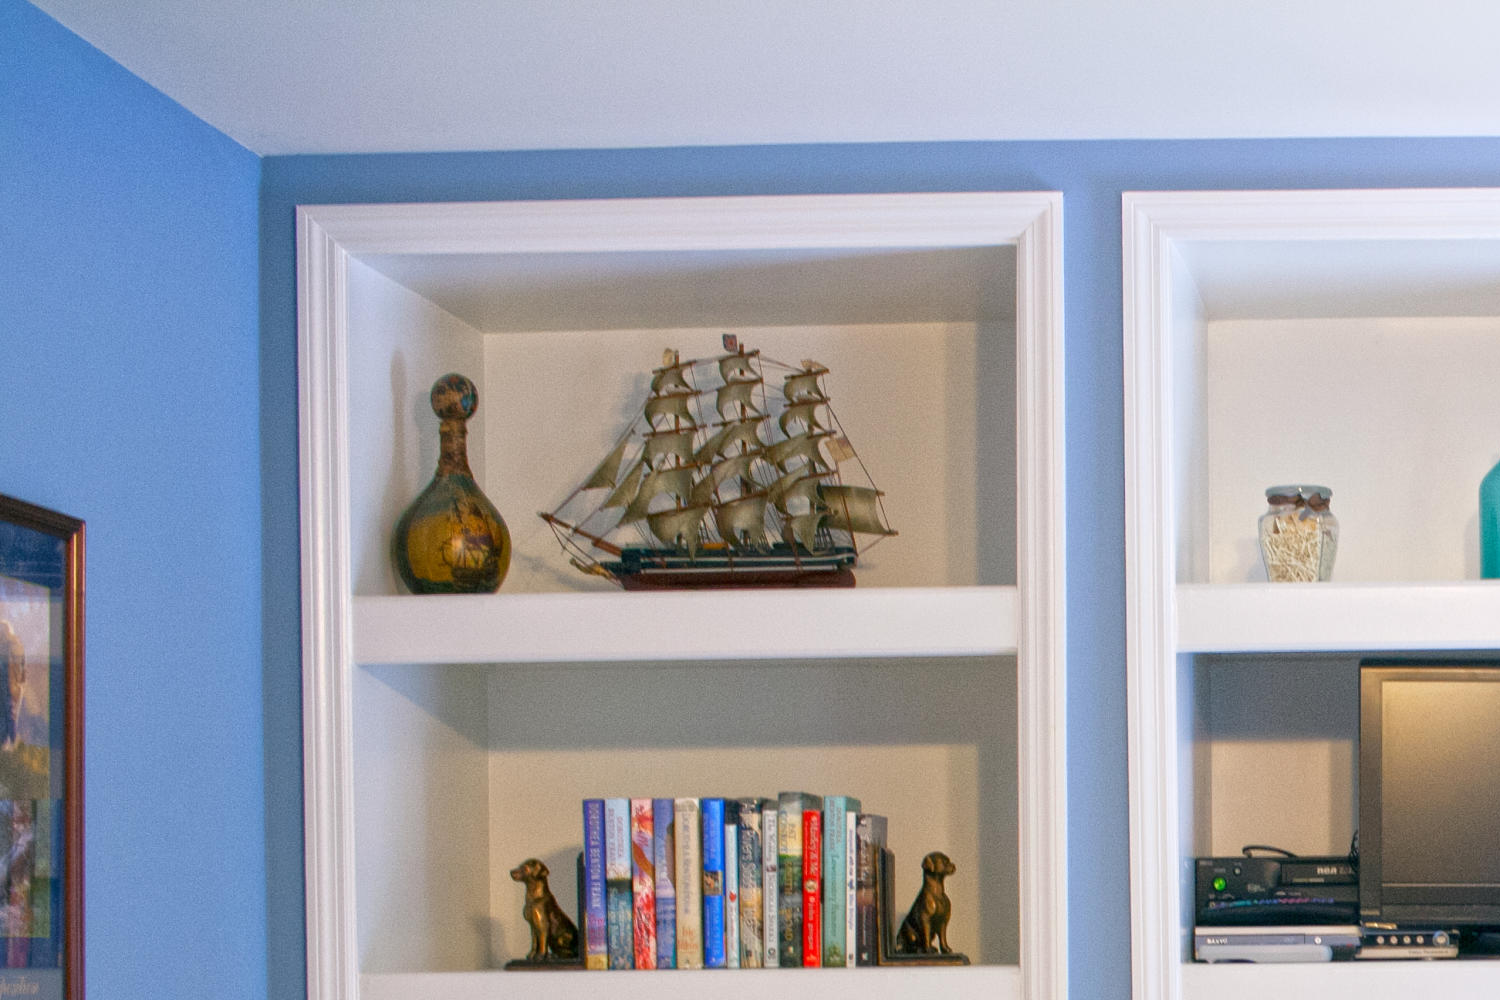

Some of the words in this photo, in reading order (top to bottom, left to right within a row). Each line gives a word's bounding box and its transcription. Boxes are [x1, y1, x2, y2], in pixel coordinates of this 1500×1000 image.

[589, 802, 600, 846] DOROTHEA
[590, 847, 601, 880] BENTON
[591, 881, 602, 910] FRANK
